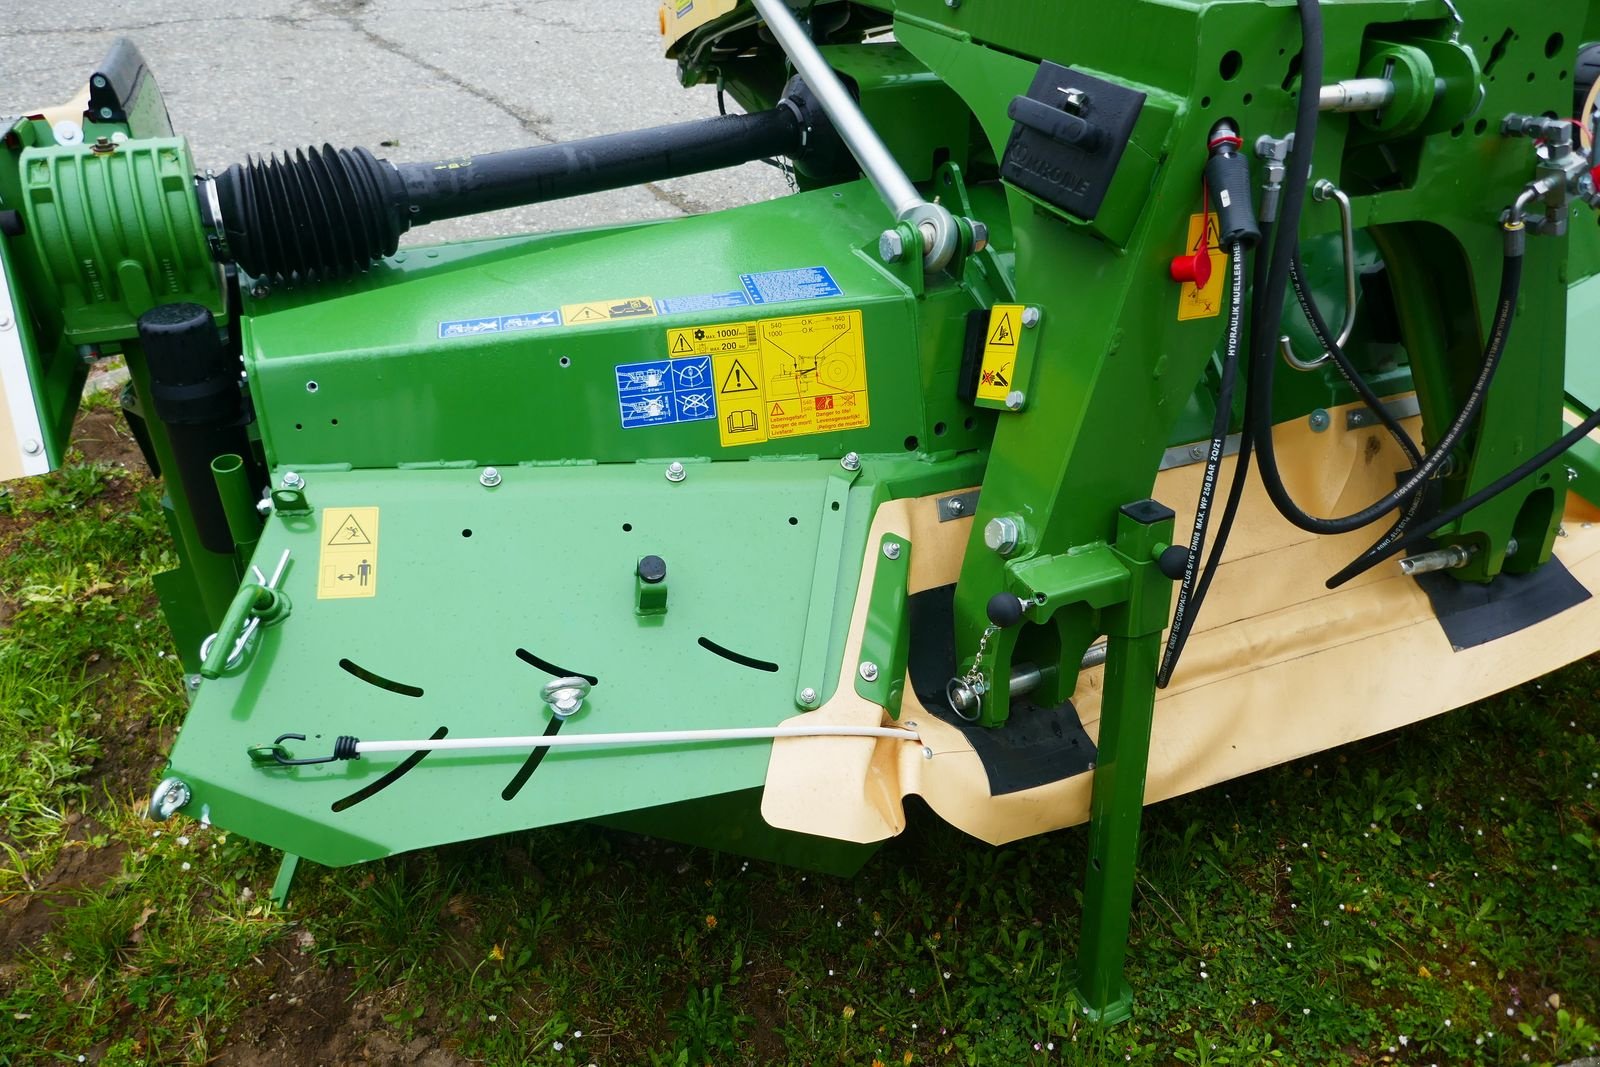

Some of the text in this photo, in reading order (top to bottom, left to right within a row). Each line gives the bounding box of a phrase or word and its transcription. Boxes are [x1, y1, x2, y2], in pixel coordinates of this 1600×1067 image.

[1233, 262, 1241, 304] MUELLER
[1228, 306, 1240, 356] HYDRAULIK
[721, 342, 737, 351] 200
[1210, 438, 1222, 461] 2Q/21
[1206, 464, 1216, 482] BAR
[1202, 482, 1212, 497] 250
[1407, 477, 1419, 489] BAR
[1200, 496, 1208, 511] WP
[1195, 511, 1206, 530] MAX.
[1183, 570, 1192, 589] PLUS
[1176, 591, 1188, 621] COMPACT
